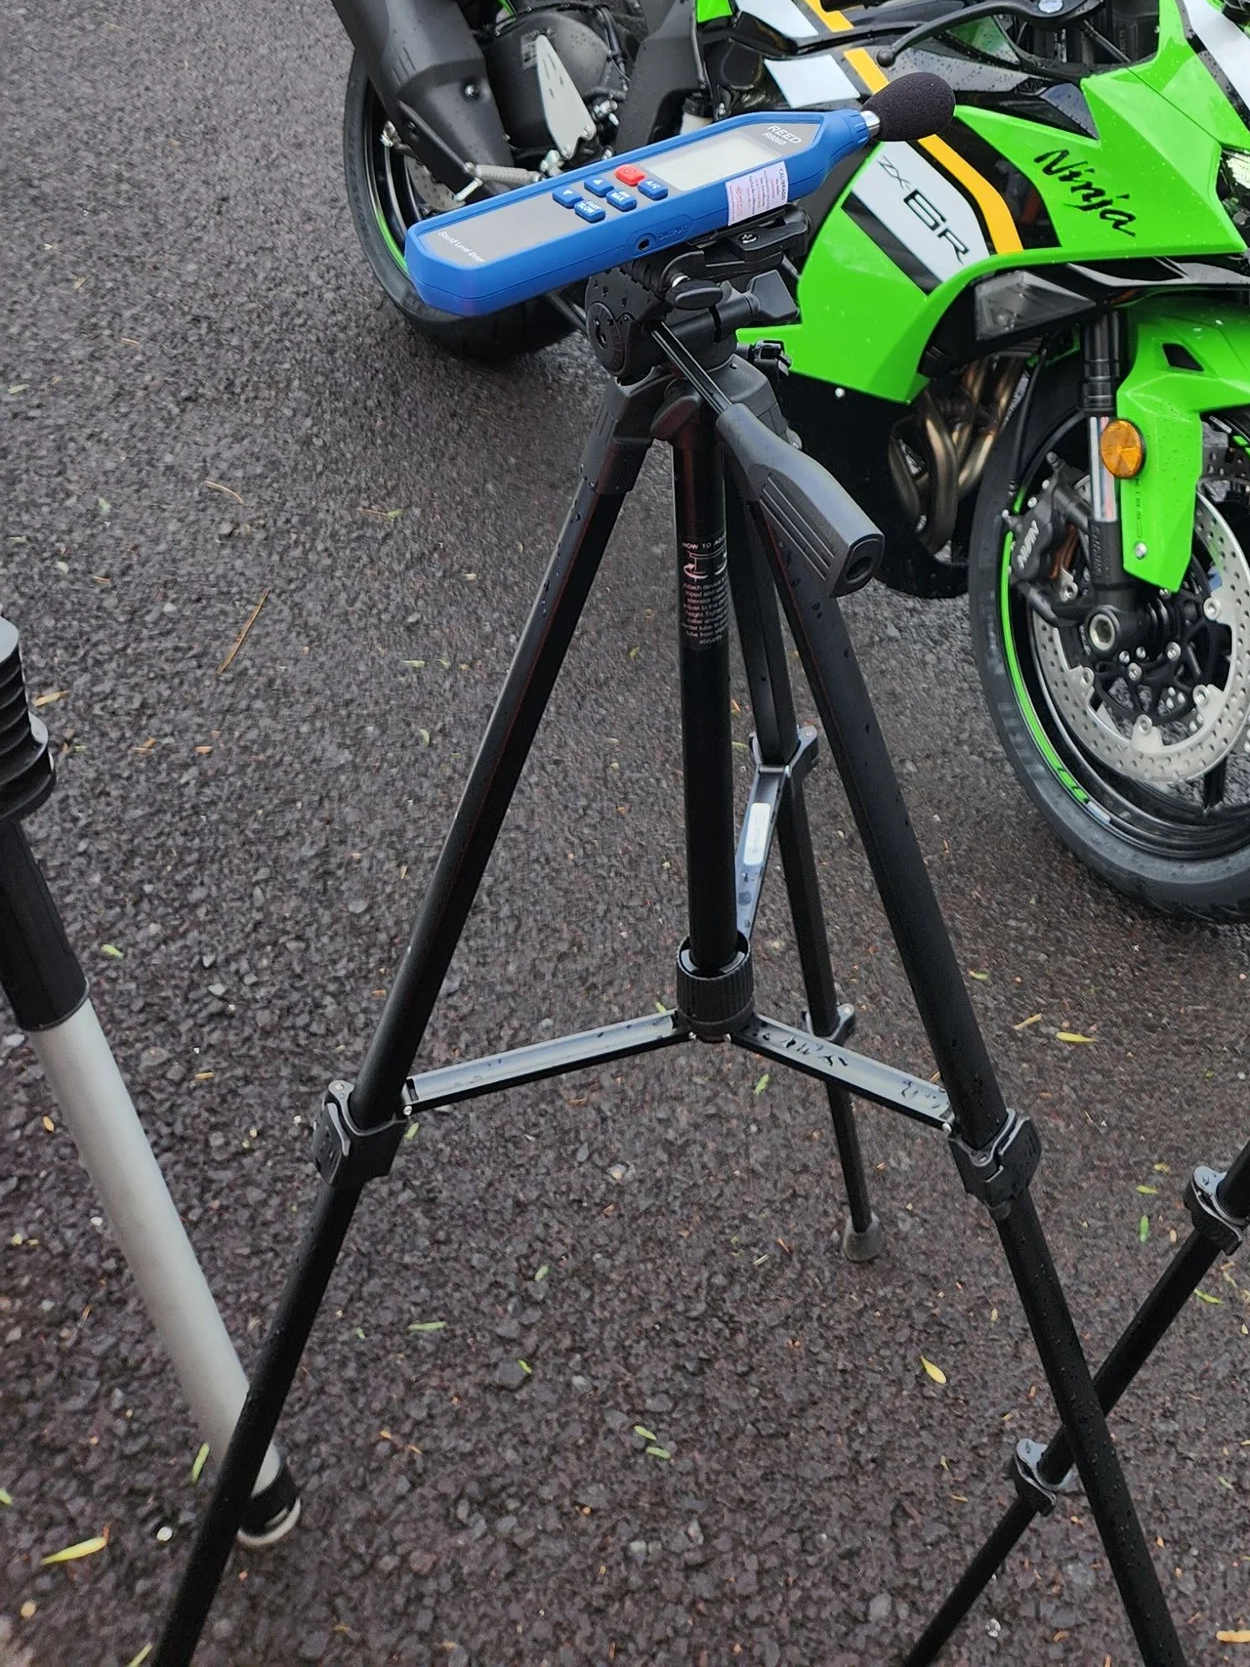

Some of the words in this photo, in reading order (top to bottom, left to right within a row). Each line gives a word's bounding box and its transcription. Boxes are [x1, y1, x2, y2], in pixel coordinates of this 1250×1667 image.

[767, 125, 803, 144] REED
[877, 155, 970, 266] ZX-6R
[1033, 149, 1136, 237] Ninja
